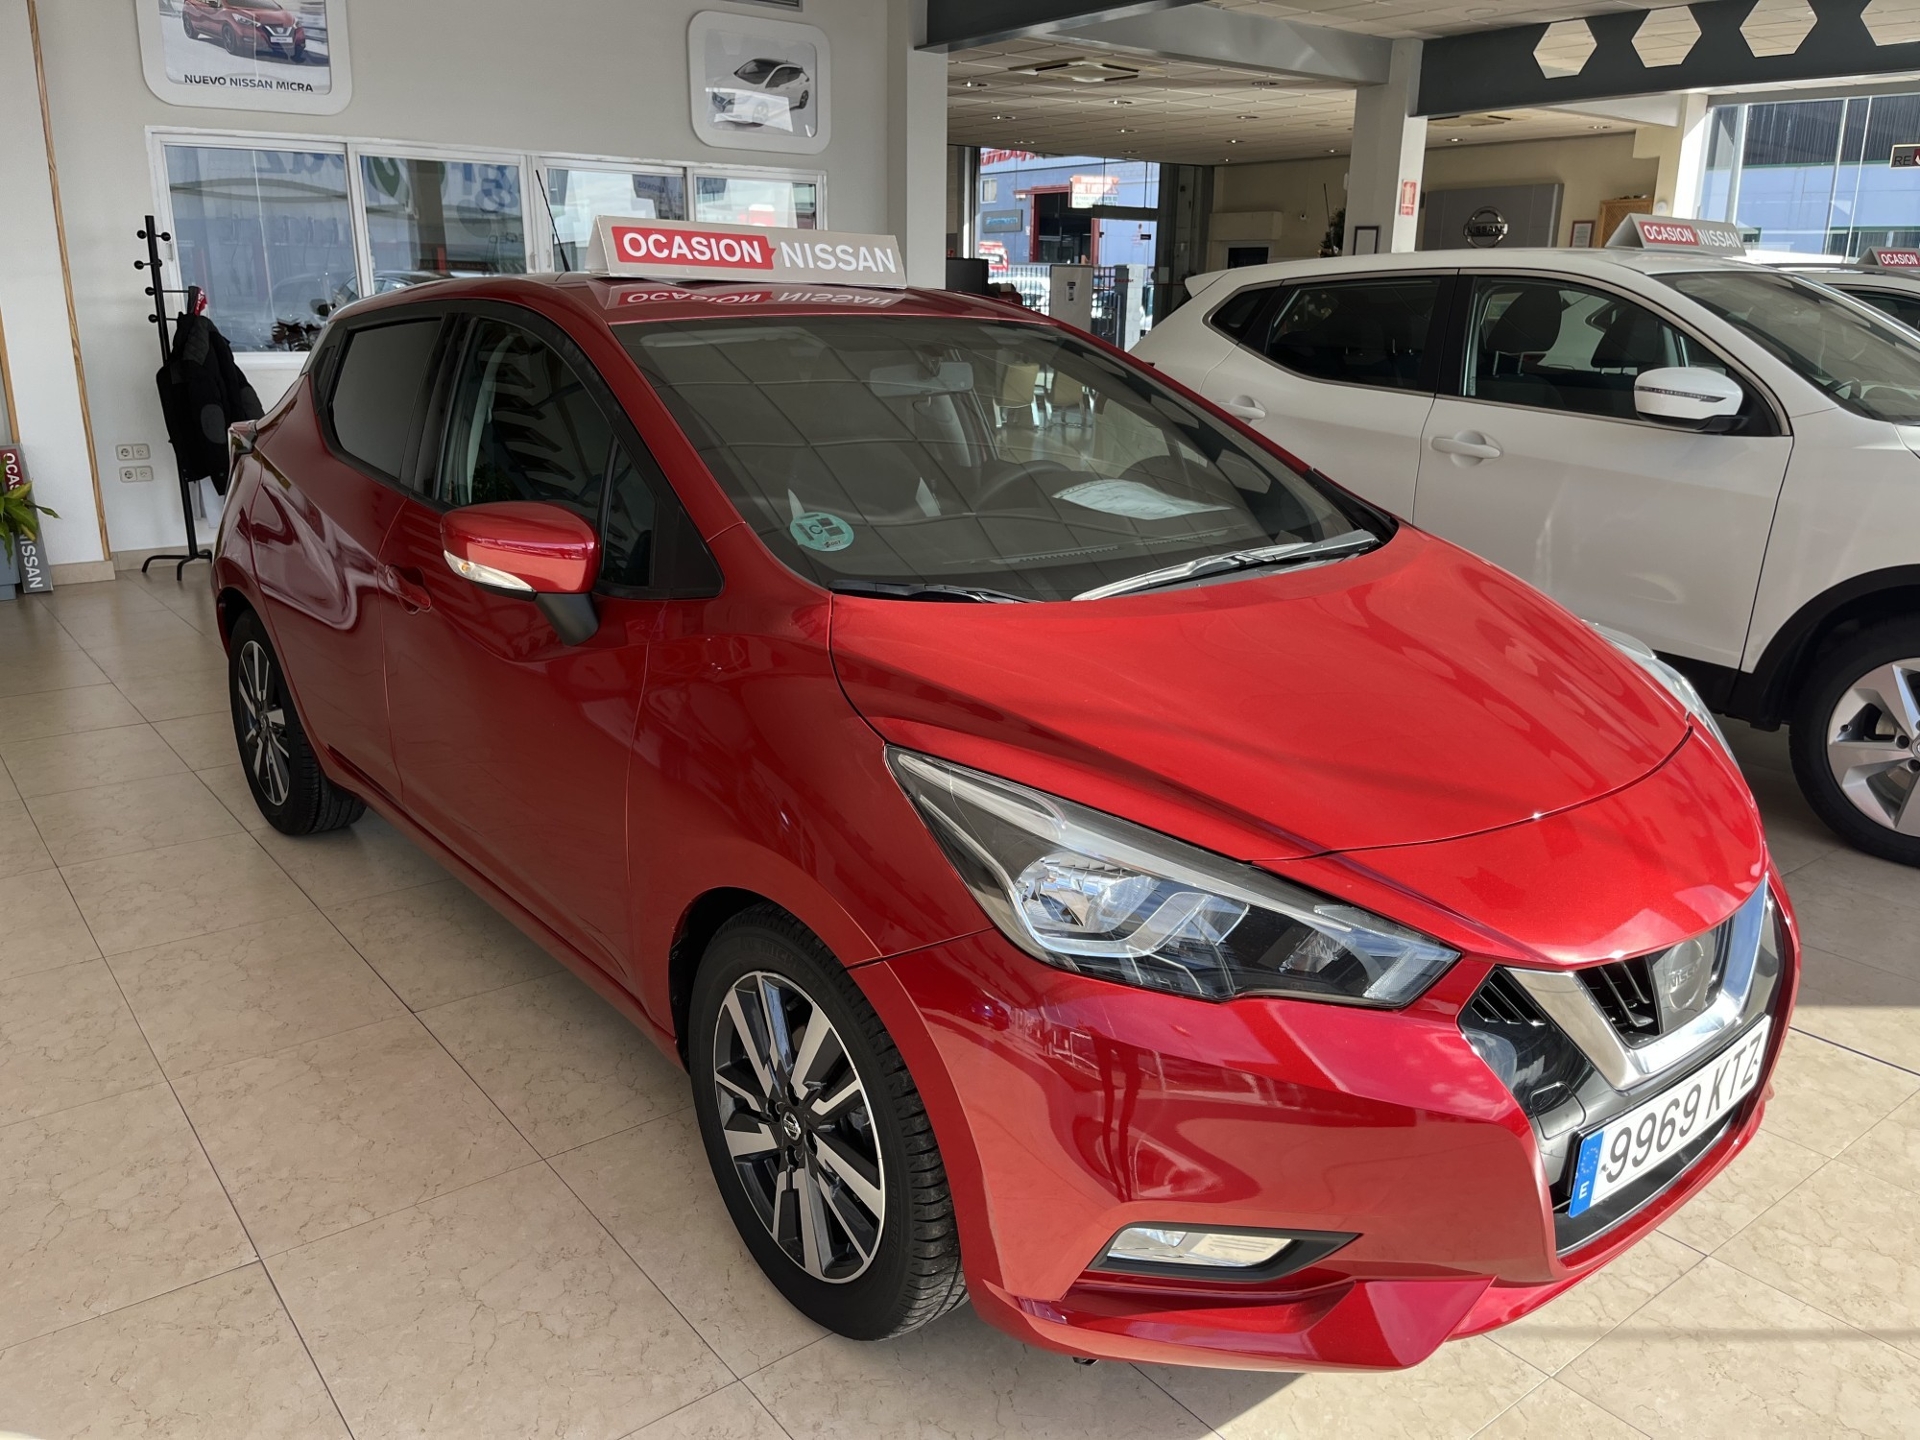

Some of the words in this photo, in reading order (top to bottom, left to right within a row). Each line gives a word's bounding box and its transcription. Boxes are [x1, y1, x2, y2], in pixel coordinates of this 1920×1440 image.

[184, 74, 227, 86] NUEVO
[230, 78, 273, 90] NISSAN
[276, 81, 314, 92] MICRA
[1467, 225, 1504, 235] NISSAN
[1643, 223, 1695, 244] OCASION
[1697, 228, 1741, 248] NISSAN
[622, 231, 764, 264] OCASION
[780, 241, 898, 274] NISSAN
[1880, 251, 1919, 266] OCASION
[809, 525, 823, 534] C
[1606, 1083, 1702, 1183] 9969
[1705, 1030, 1763, 1121] KTZ
[1578, 1183, 1588, 1199] E
